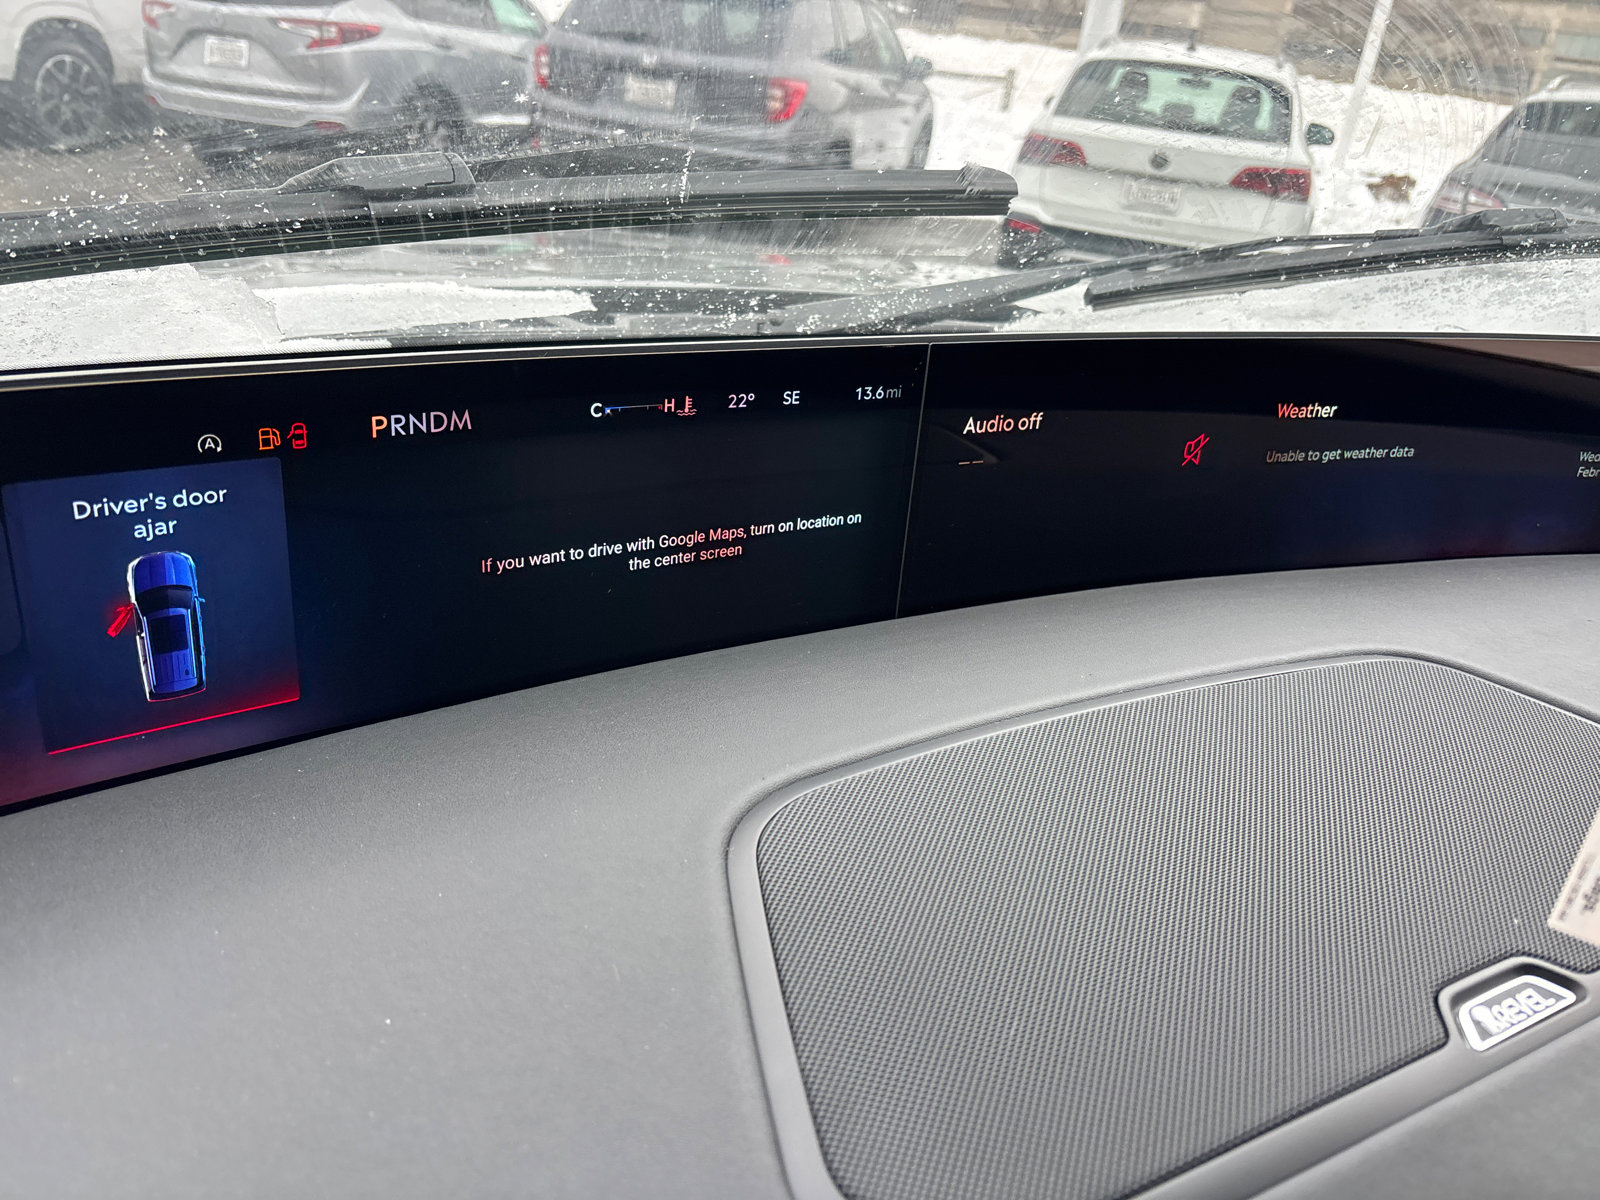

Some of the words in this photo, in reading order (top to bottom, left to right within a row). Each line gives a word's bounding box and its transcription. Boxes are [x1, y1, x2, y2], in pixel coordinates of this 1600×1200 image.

[664, 398, 675, 413] H
[728, 392, 756, 409] 22°
[782, 390, 801, 405] SE
[590, 402, 603, 418] C
[1277, 402, 1338, 419] Weather
[963, 415, 1014, 434] Audio
[1018, 412, 1043, 430] off
[1266, 449, 1306, 463] Unable
[1307, 450, 1321, 461] to
[1321, 448, 1342, 464] get
[1343, 446, 1389, 459] weather
[1389, 445, 1415, 458] data
[73, 493, 166, 519] Driver's
[173, 489, 226, 507] door
[134, 519, 177, 541] ajar
[481, 557, 493, 574] If
[497, 557, 524, 574] you
[528, 549, 566, 566] want
[568, 547, 585, 561] to
[587, 542, 623, 558] drive
[626, 536, 655, 553] with
[658, 530, 706, 548] Google
[709, 527, 747, 542] Maps,
[749, 523, 775, 536] turn
[777, 521, 794, 533] on
[796, 514, 845, 531] location
[846, 513, 862, 525] on
[628, 556, 651, 571] the
[654, 551, 697, 567] center
[699, 545, 743, 561] screen
